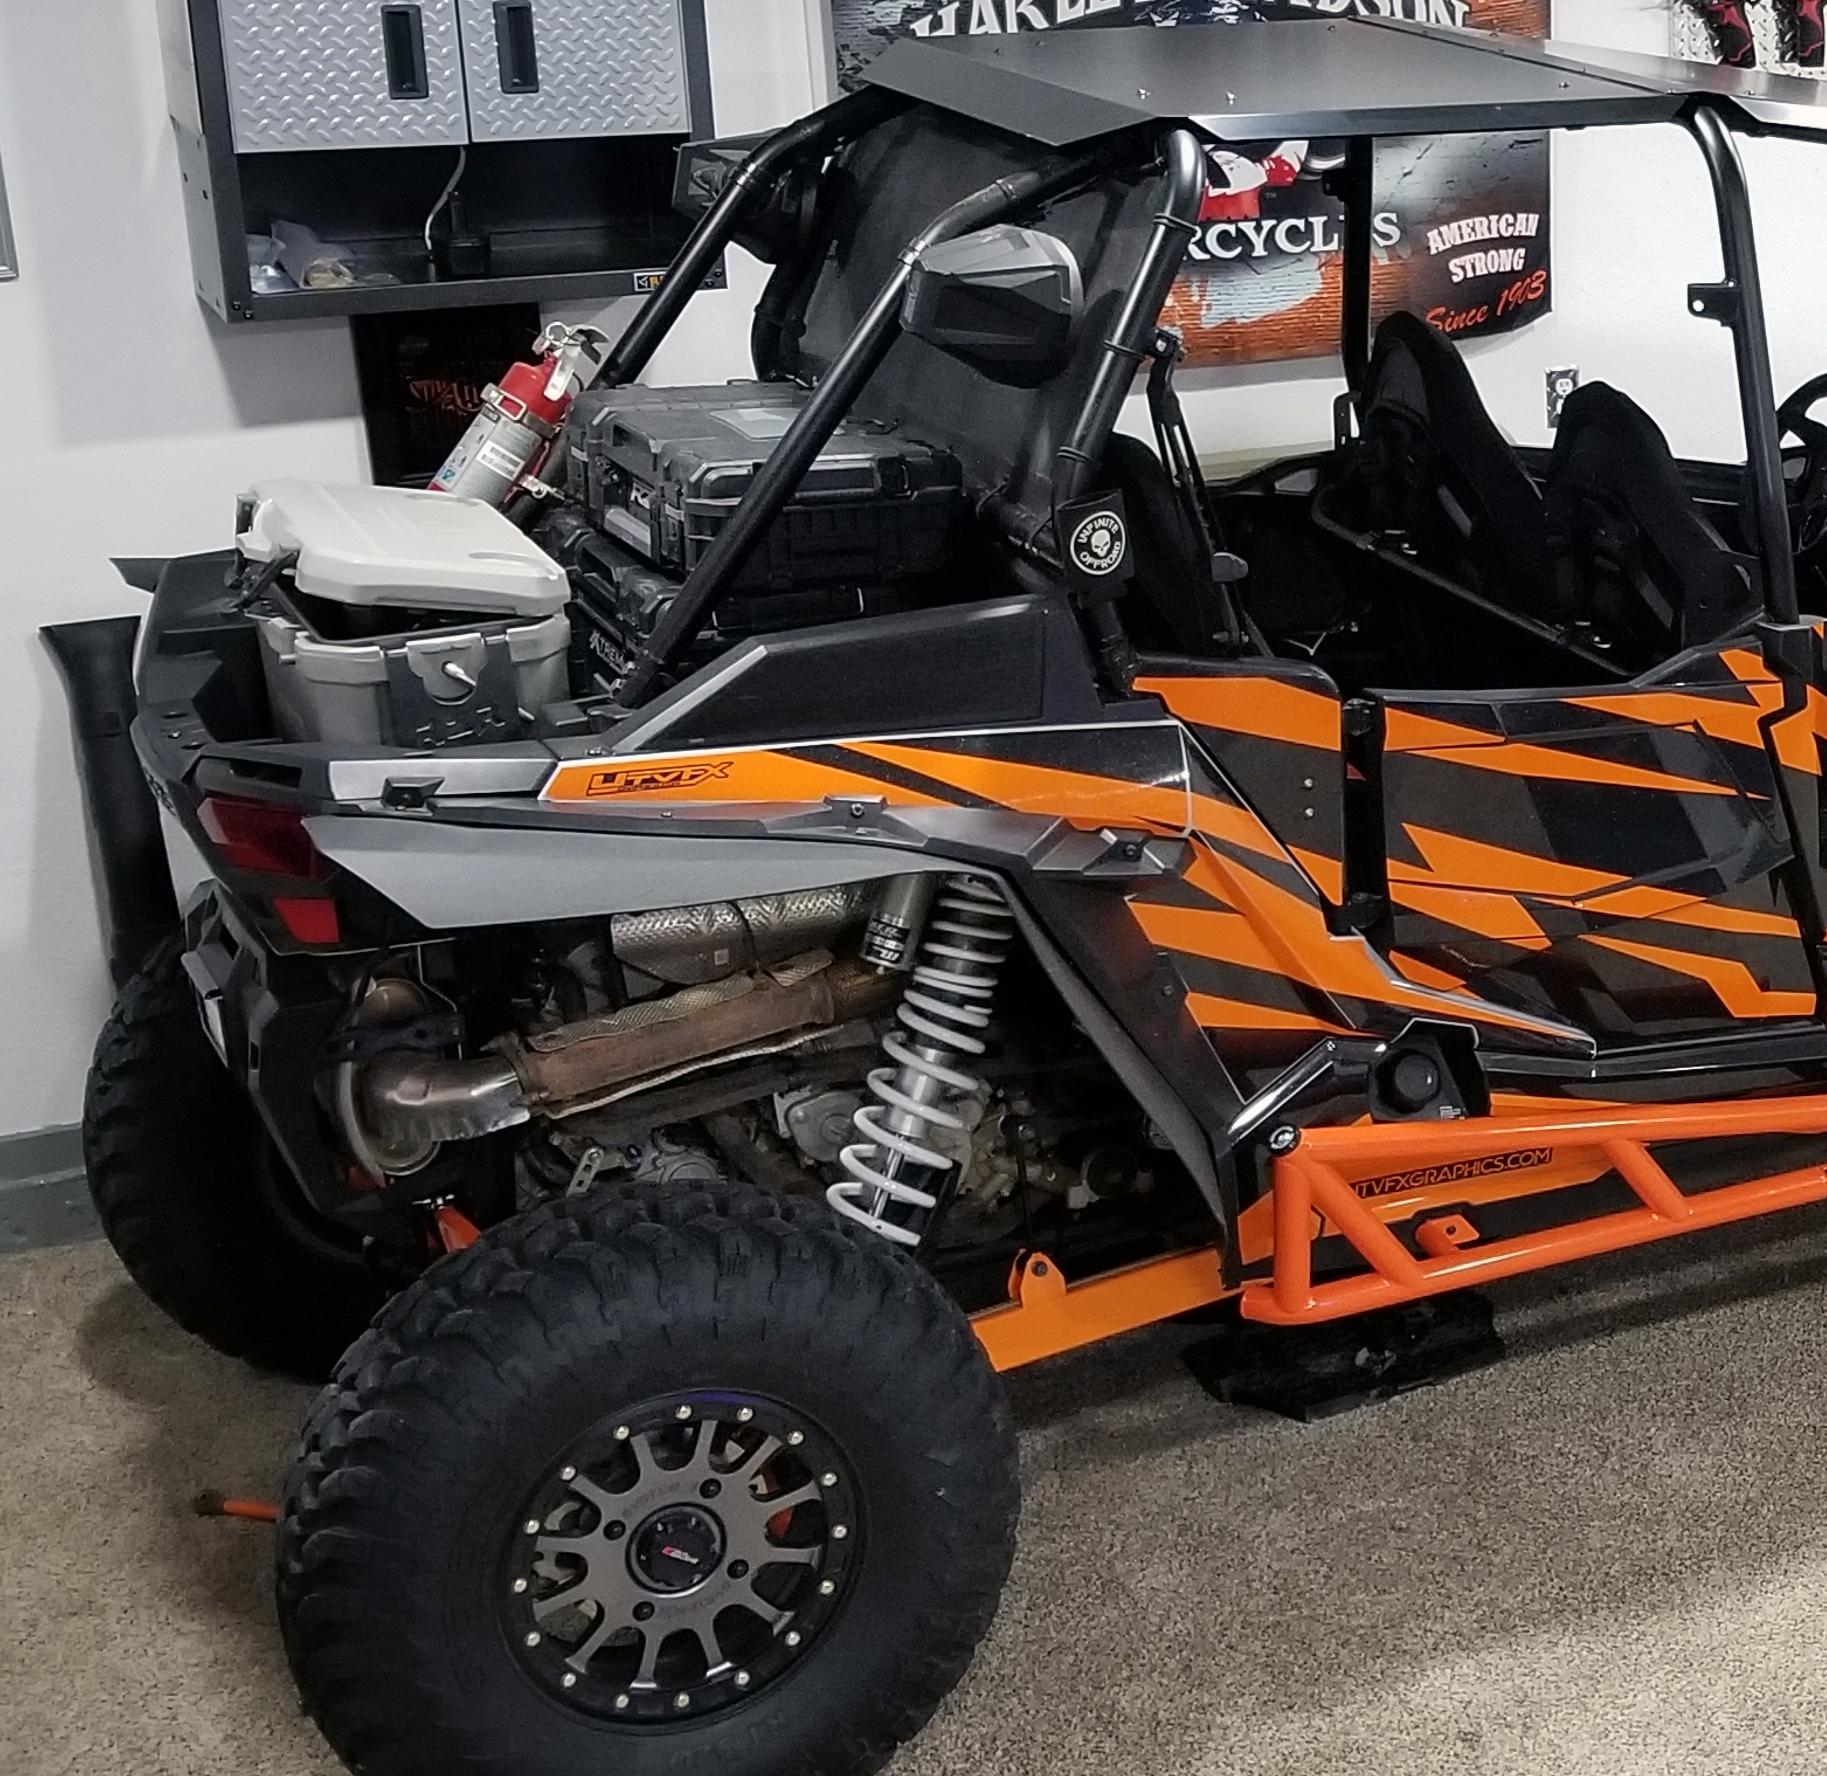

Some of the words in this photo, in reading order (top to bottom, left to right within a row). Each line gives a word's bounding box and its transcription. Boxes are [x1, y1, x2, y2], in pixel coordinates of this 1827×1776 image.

[1427, 213, 1540, 255] AMERICAN
[1448, 248, 1526, 283] STRONG
[1425, 305, 1489, 332] Since
[1496, 269, 1547, 316] 1903
[1077, 517, 1119, 543] INFINITE
[1080, 541, 1121, 569] OFFROAD
